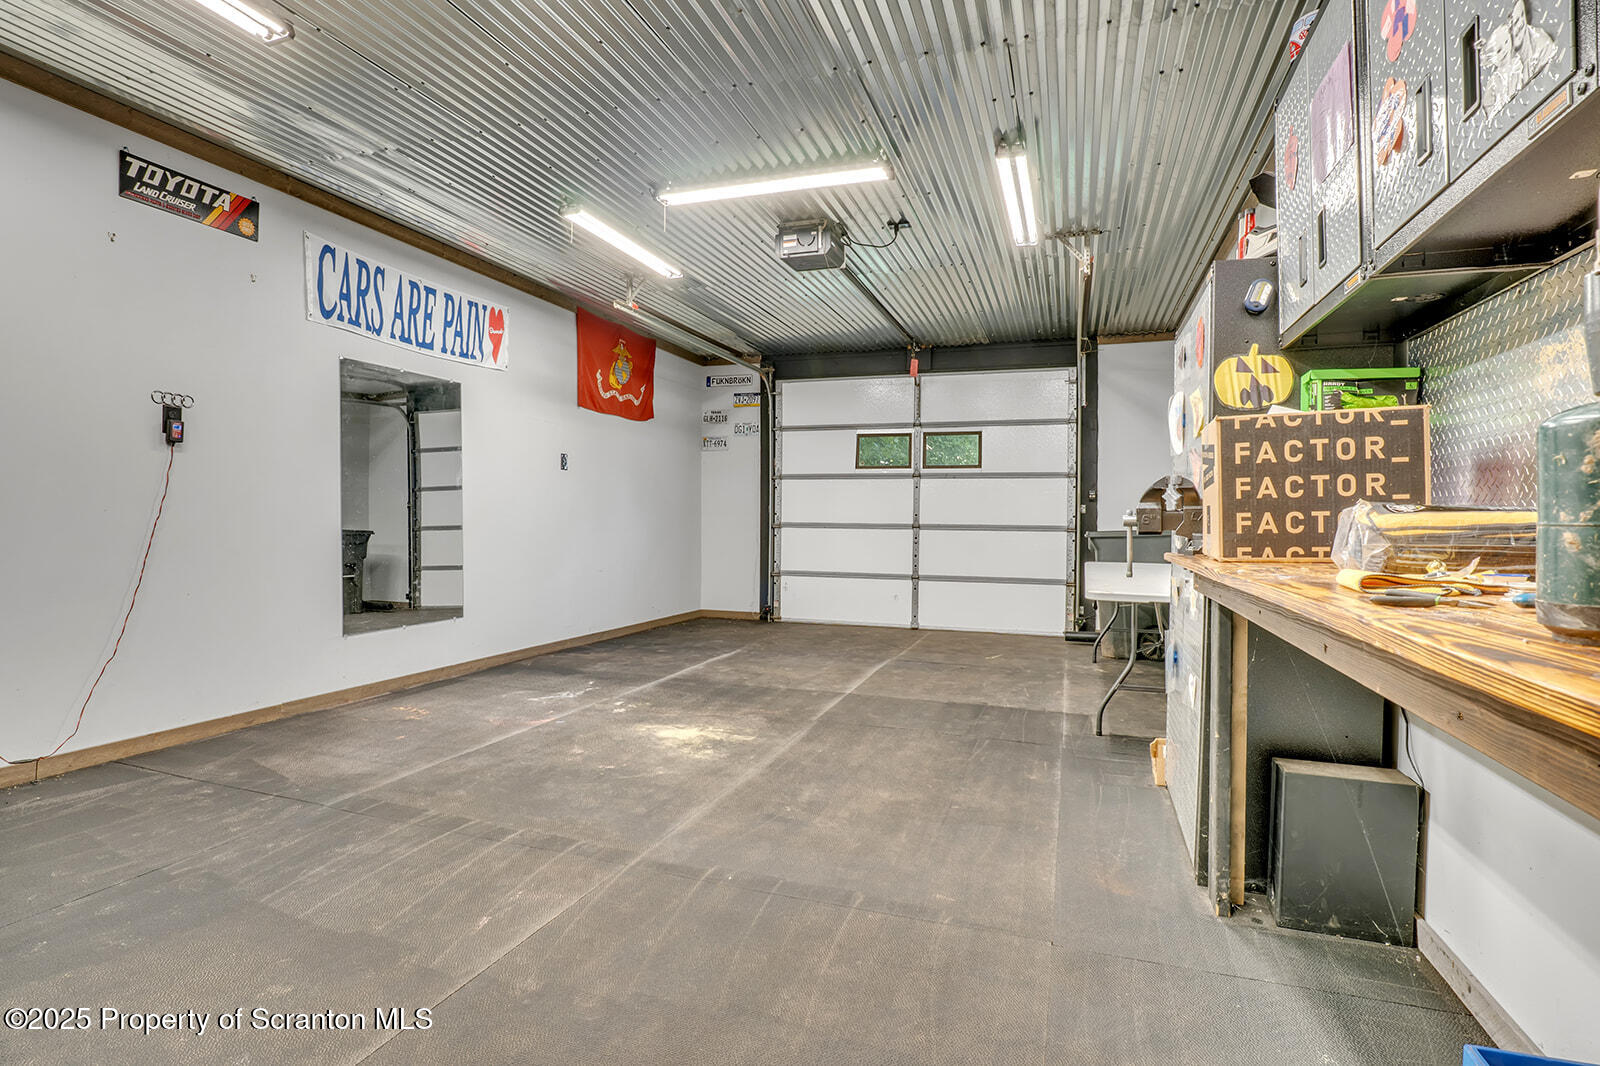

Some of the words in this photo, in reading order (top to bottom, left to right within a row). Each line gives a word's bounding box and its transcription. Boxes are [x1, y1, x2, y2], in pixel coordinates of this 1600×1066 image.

[125, 156, 231, 212] TOYOTA
[134, 182, 160, 198] LAND
[159, 191, 197, 212] CRUISER
[317, 244, 385, 337] CARS
[390, 274, 437, 351] ARE
[441, 292, 488, 363] PAIN
[1234, 436, 1410, 464] FACTOR_
[1235, 473, 1411, 499] FACTOR_
[1236, 510, 1342, 534] FACT
